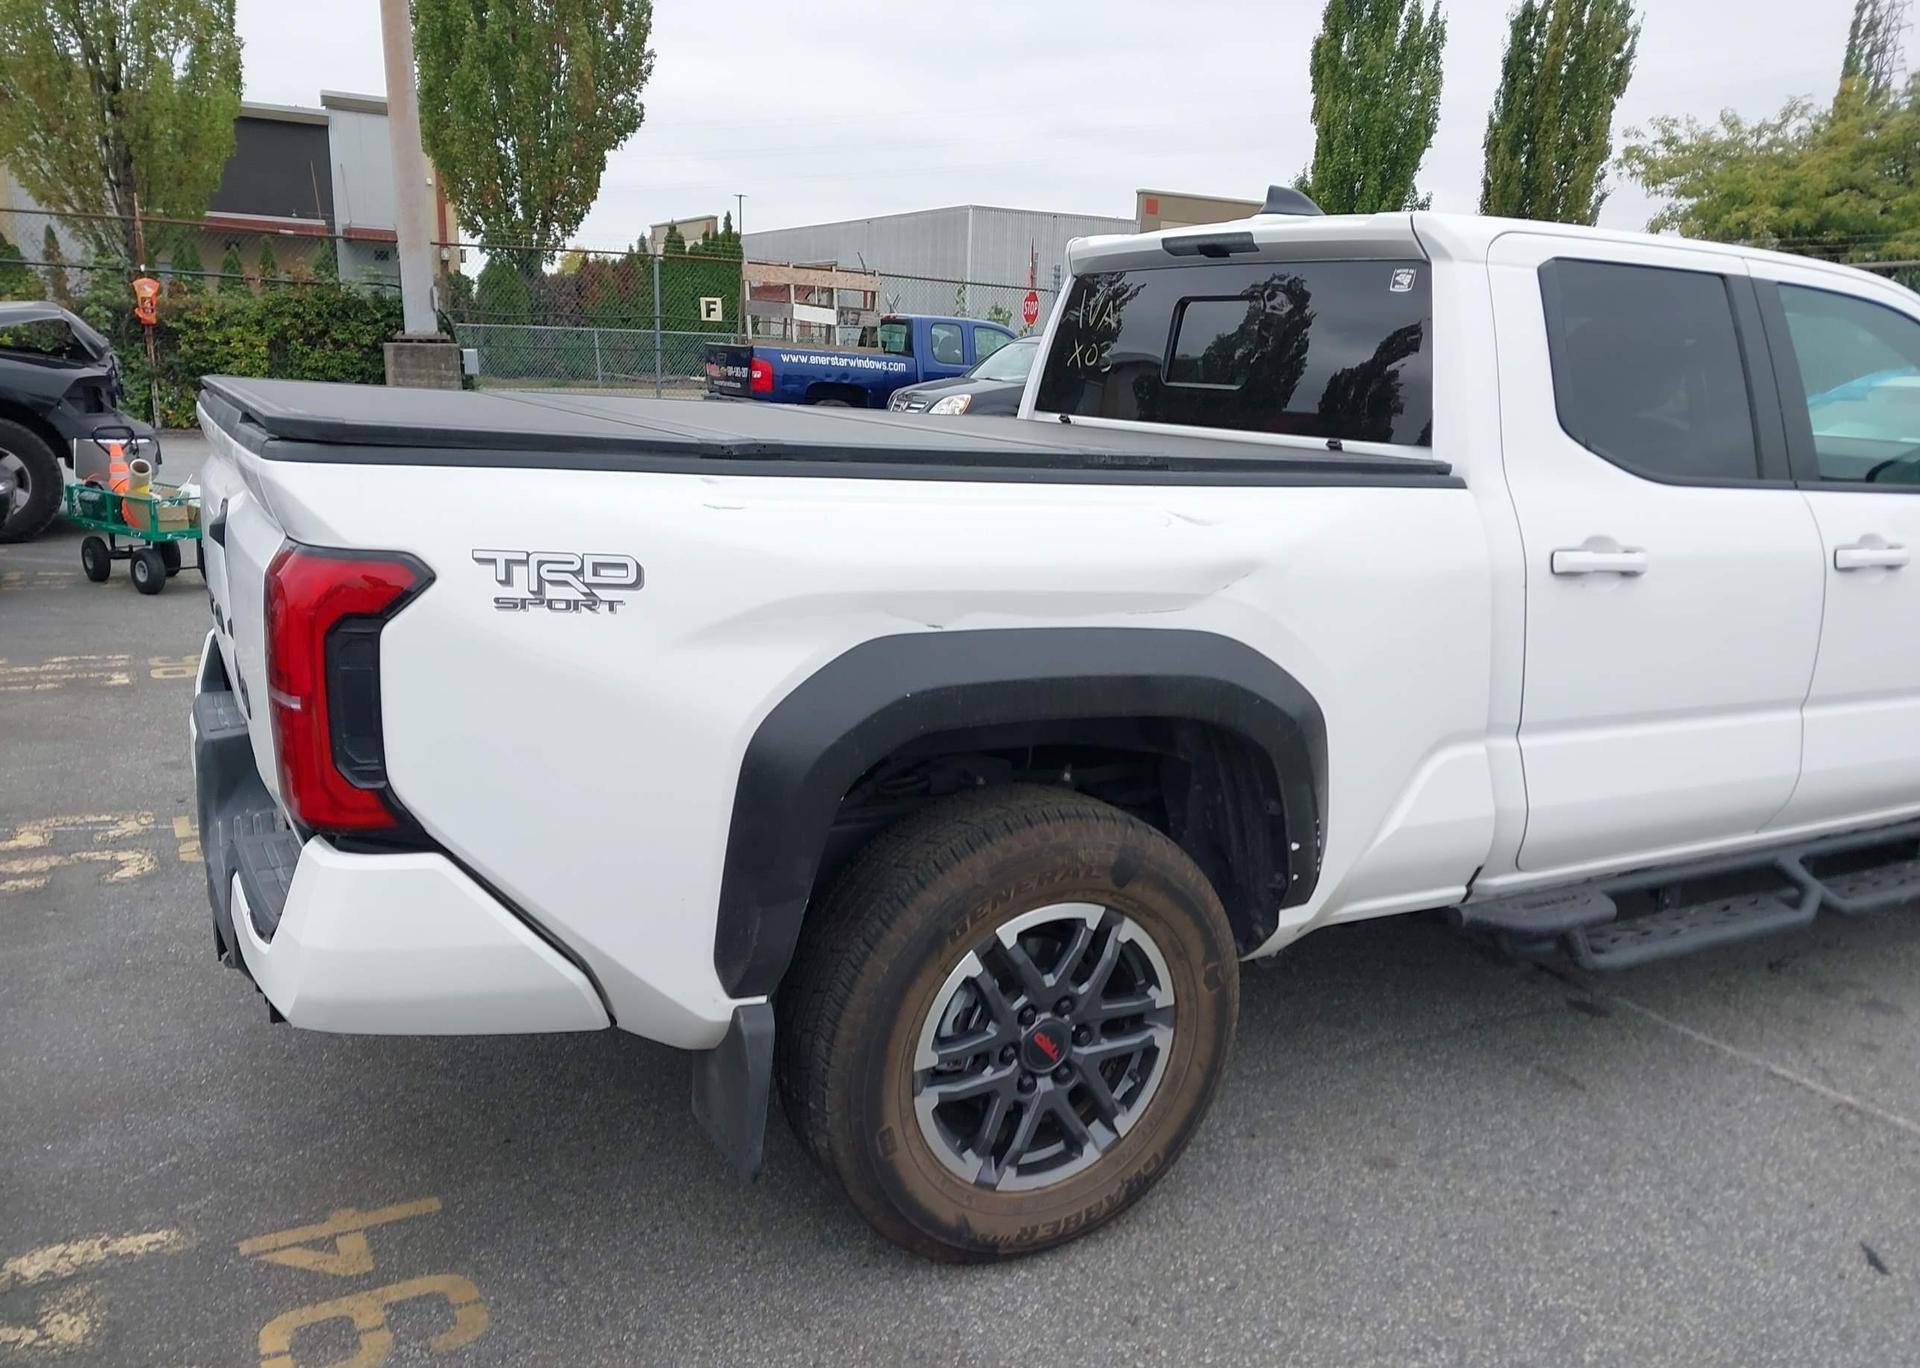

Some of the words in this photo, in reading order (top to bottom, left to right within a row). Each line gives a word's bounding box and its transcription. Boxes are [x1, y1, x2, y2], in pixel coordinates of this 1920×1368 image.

[705, 300, 717, 318] F
[1024, 300, 1039, 315] STOP
[780, 352, 907, 373] www.enerstarwindows.com
[472, 549, 645, 601] TRD
[493, 597, 625, 614] SPORT
